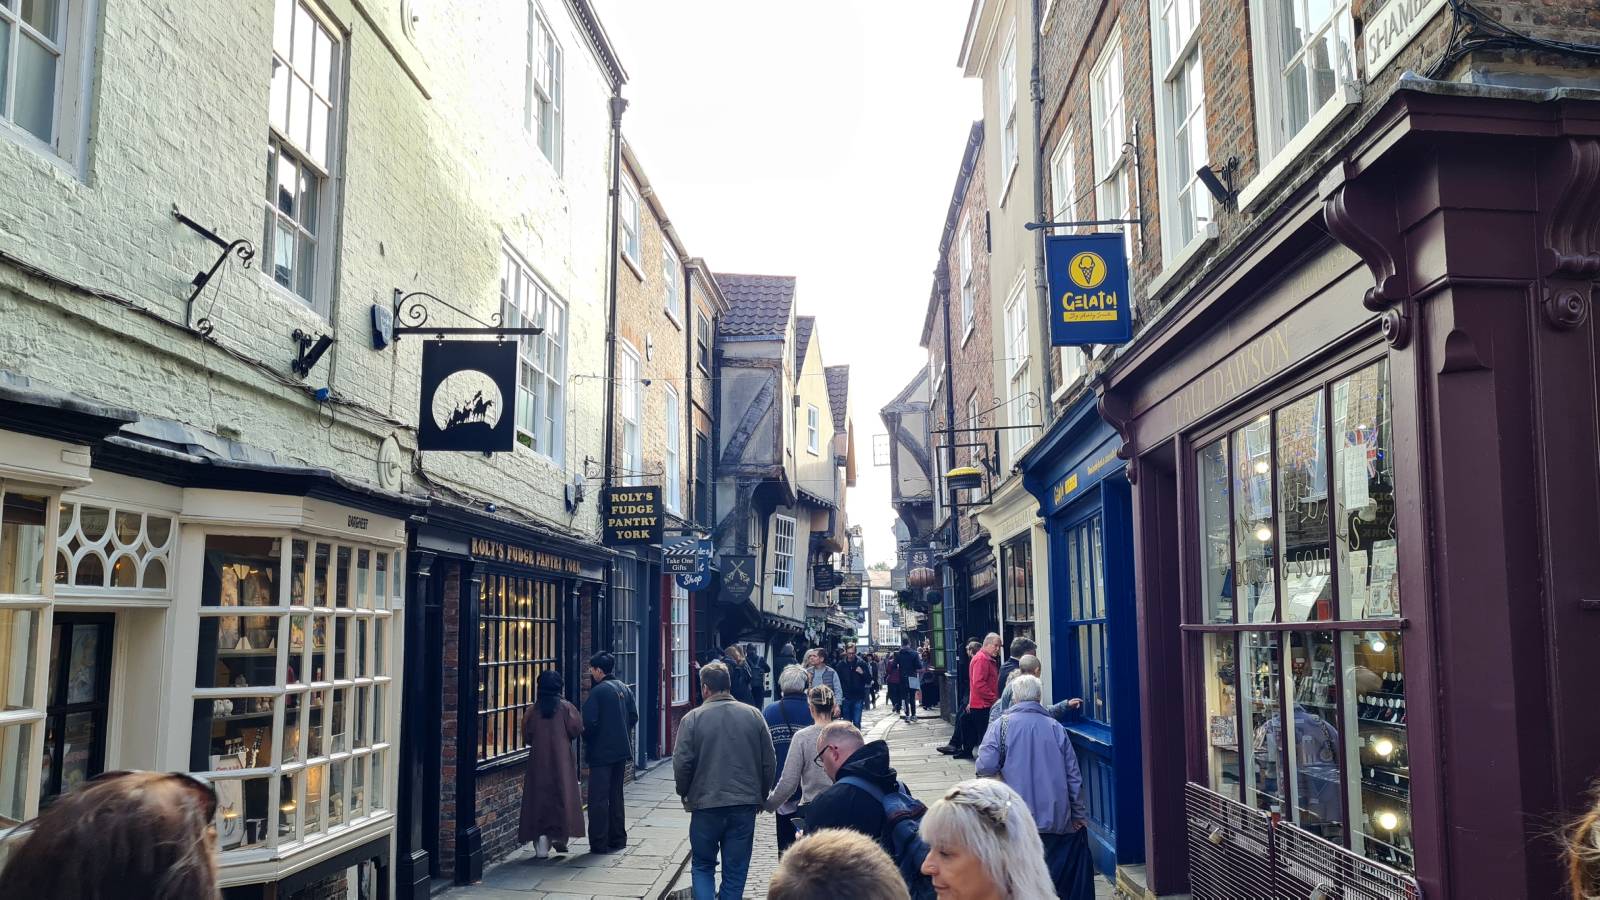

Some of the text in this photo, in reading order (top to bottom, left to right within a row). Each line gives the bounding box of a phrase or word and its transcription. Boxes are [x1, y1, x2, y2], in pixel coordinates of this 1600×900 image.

[1369, 0, 1429, 65] SHAMB
[1175, 322, 1290, 428] PAUL DAWSON
[611, 492, 653, 502] ROLY'S
[611, 504, 654, 515] FUDGE
[608, 517, 657, 527] PANTRY
[616, 530, 650, 539] YORK
[471, 537, 582, 576] ROLY'S FUDGE PANTRY YORK
[1235, 556, 1274, 586] BOUGH
[683, 574, 703, 586] Shop
